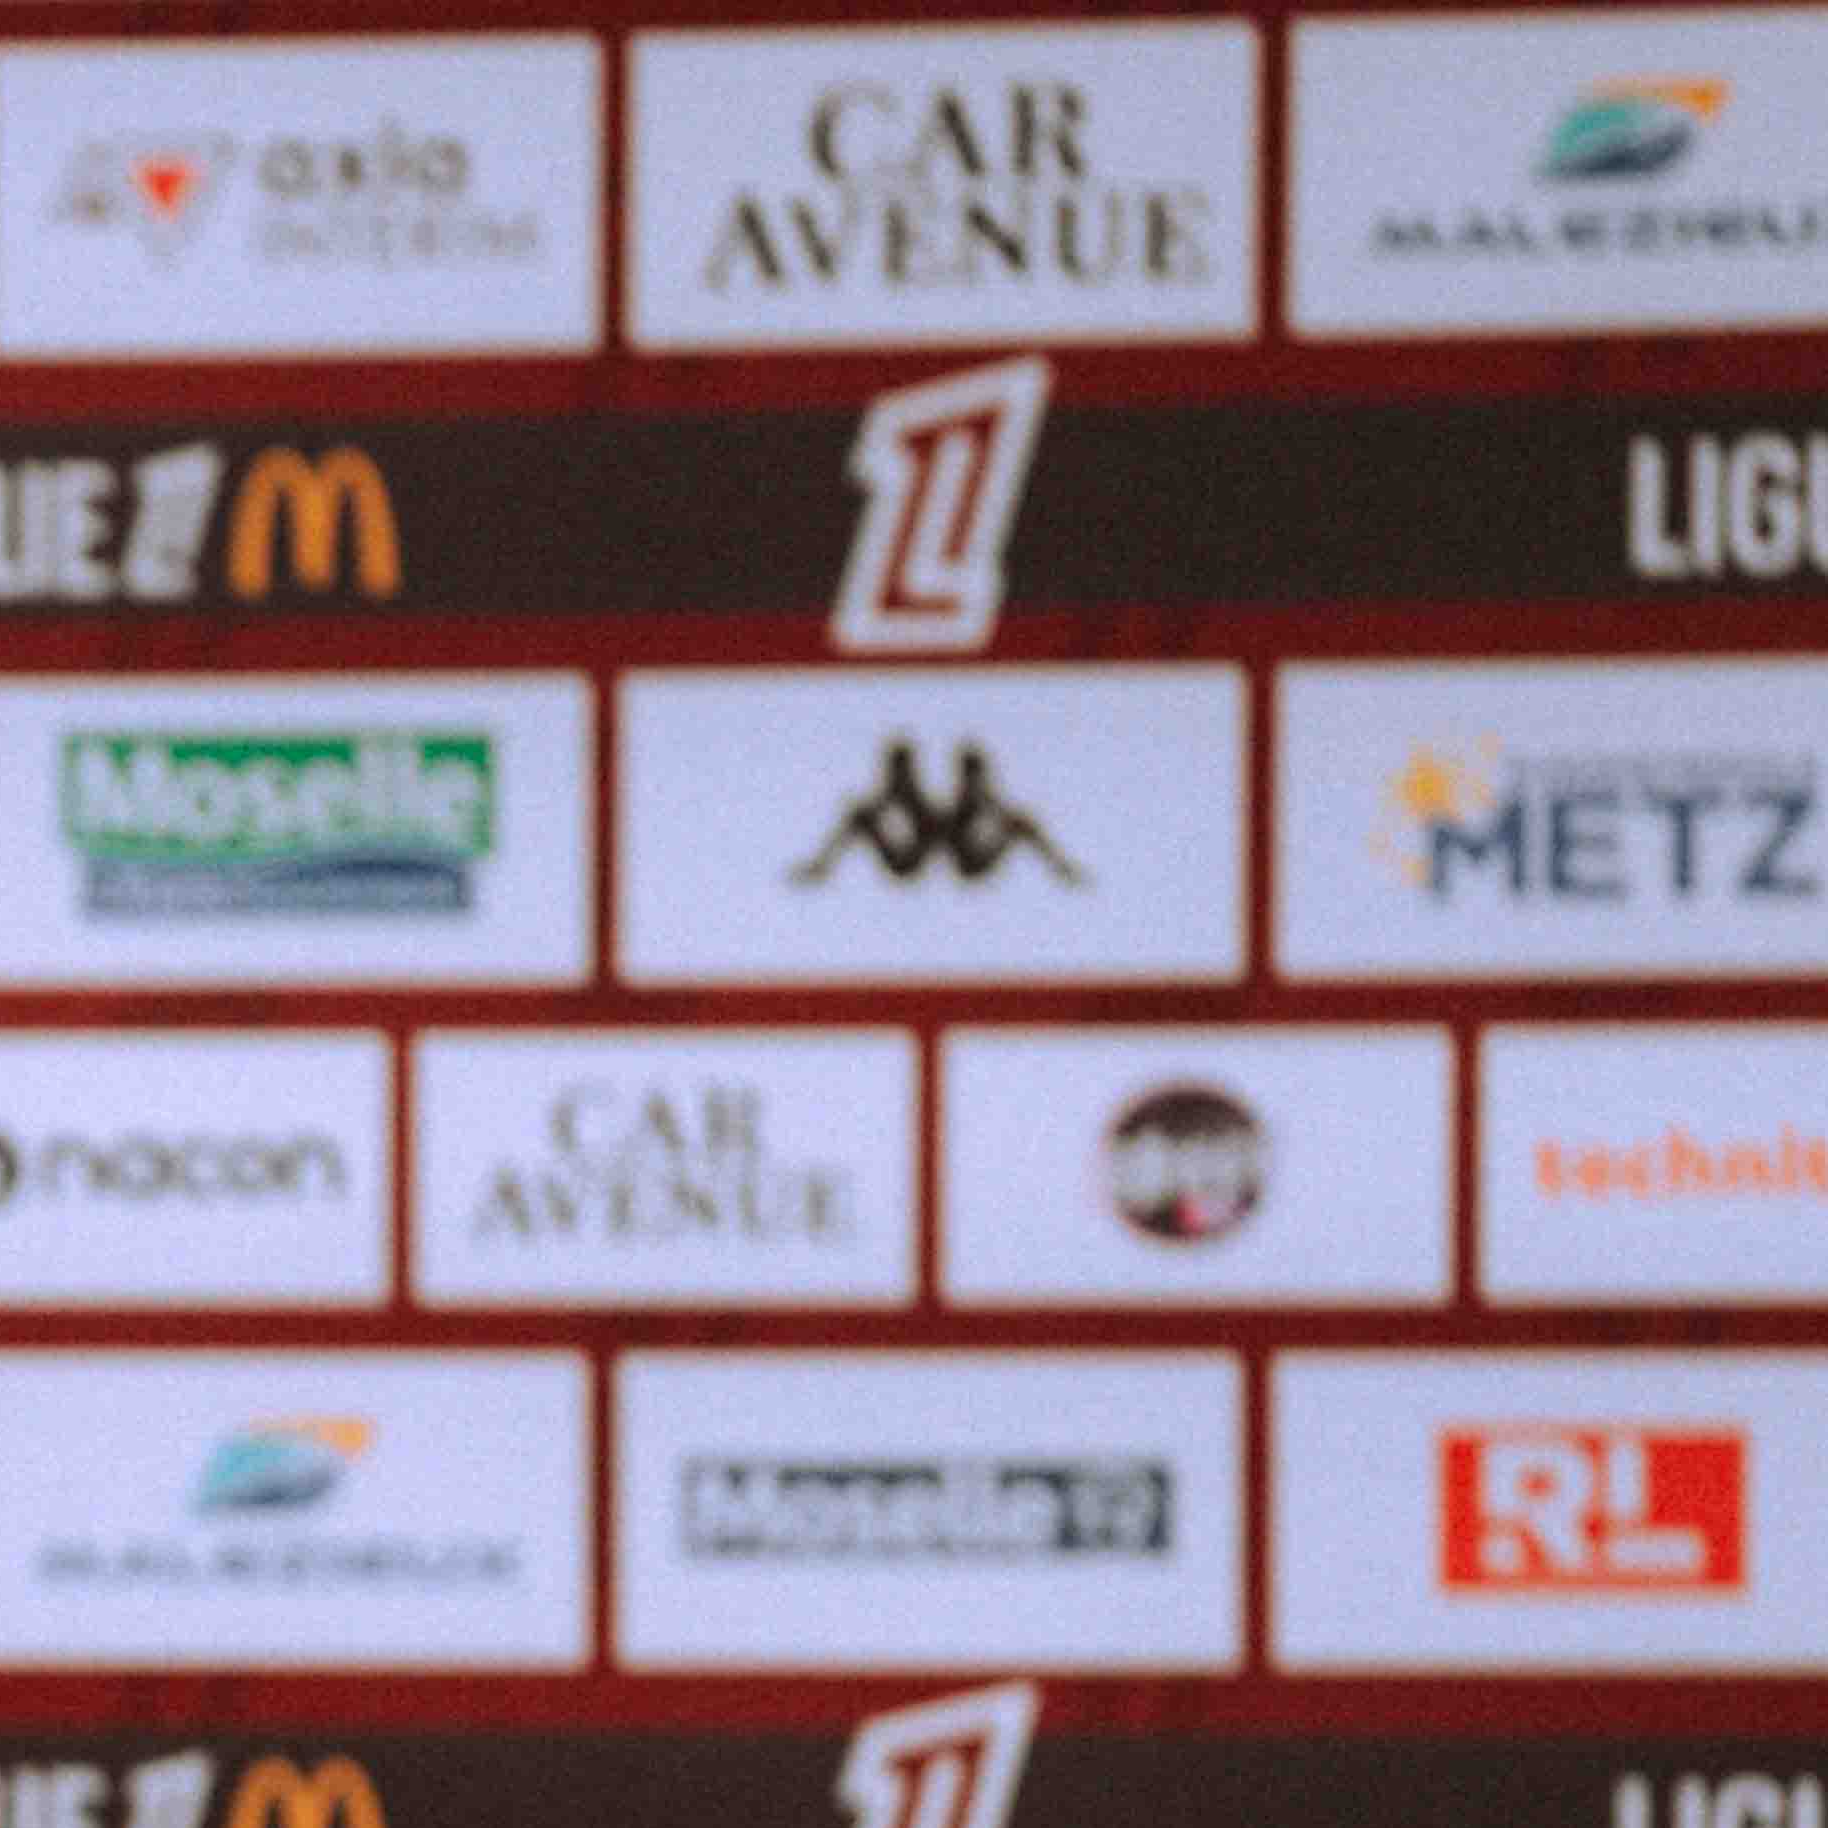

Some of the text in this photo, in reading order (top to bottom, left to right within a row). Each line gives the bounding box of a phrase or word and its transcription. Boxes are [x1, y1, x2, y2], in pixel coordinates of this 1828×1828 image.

[805, 77, 1088, 184] CAR
[705, 188, 1210, 289] AVENUE
[1626, 430, 1828, 579] LIG
[1425, 796, 1824, 903] METZ
[28, 1126, 343, 1194] nacon
[549, 1079, 763, 1158] CAR
[471, 1161, 850, 1242] AVENUE
[1477, 1440, 1709, 1578] RL
